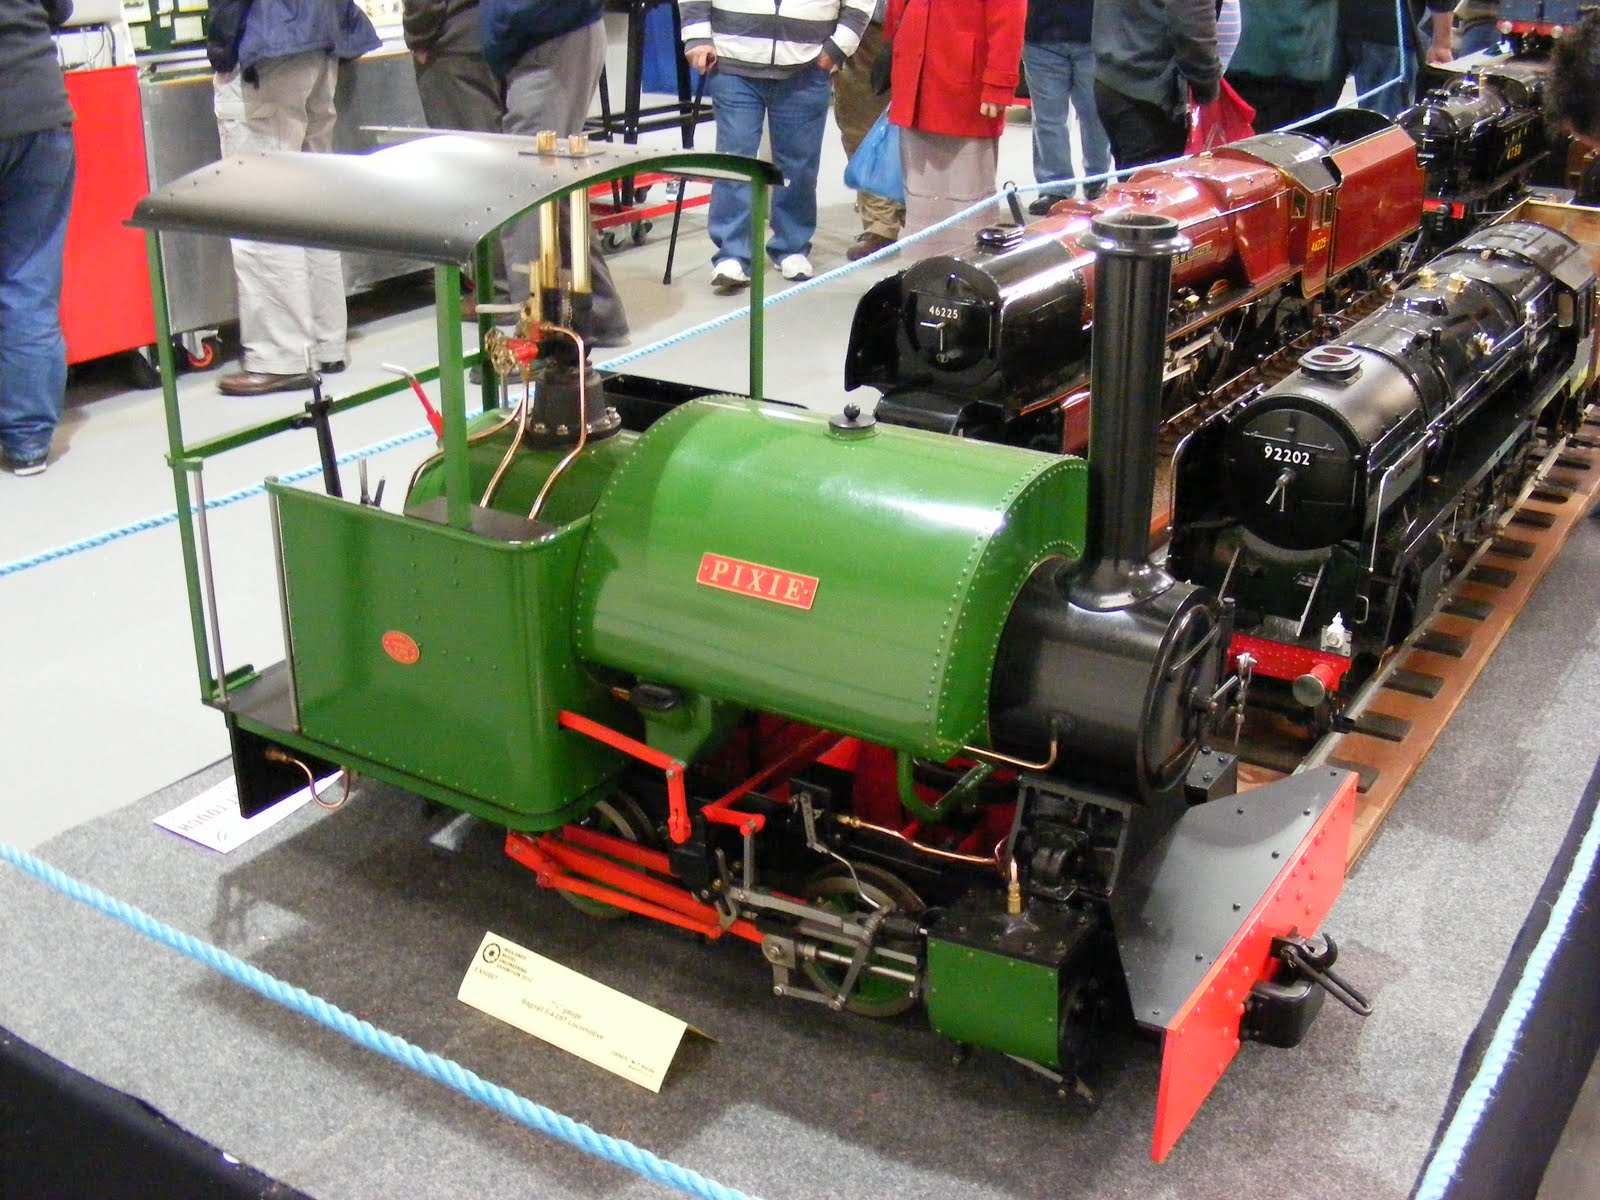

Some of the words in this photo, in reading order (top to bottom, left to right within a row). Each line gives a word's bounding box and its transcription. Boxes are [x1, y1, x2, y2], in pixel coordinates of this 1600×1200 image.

[929, 305, 958, 320] 46225
[1264, 445, 1310, 466] 92202
[710, 560, 805, 601] PIXIE
